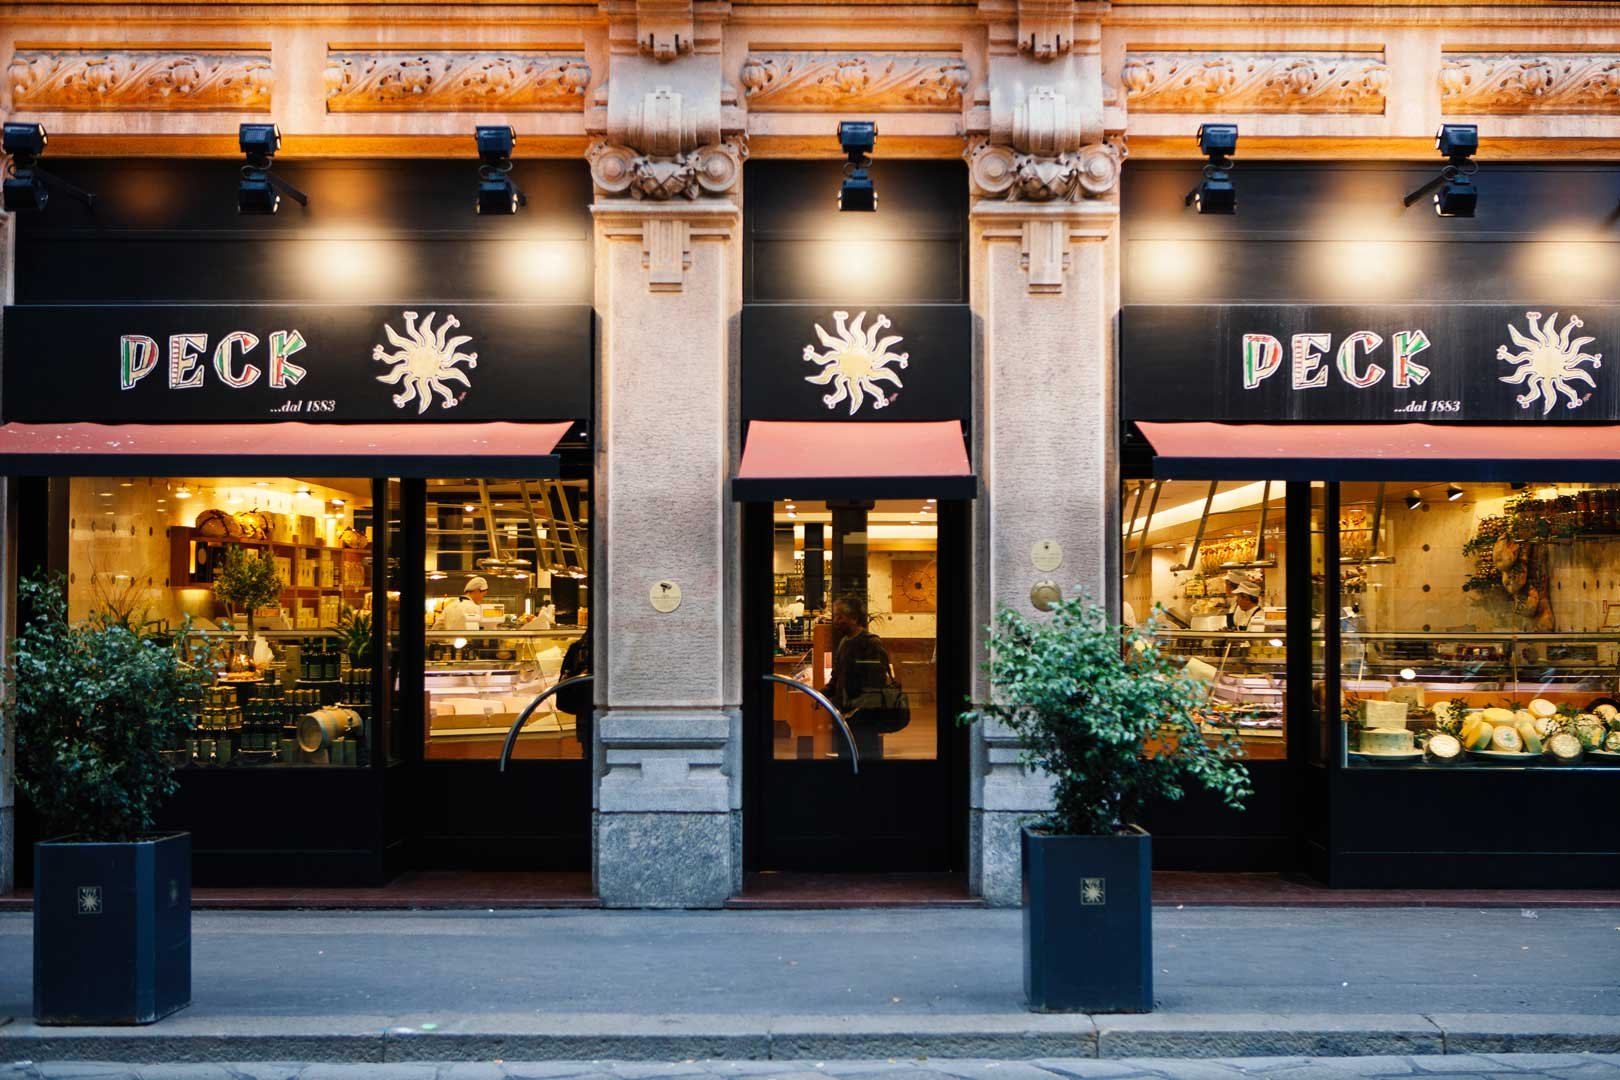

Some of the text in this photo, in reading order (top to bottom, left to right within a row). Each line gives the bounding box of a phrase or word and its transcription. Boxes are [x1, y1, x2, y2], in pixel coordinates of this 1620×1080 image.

[120, 329, 307, 390] PECK
[1242, 329, 1431, 390] PECK
[306, 400, 336, 412] 1883
[1430, 400, 1461, 412] 1883
